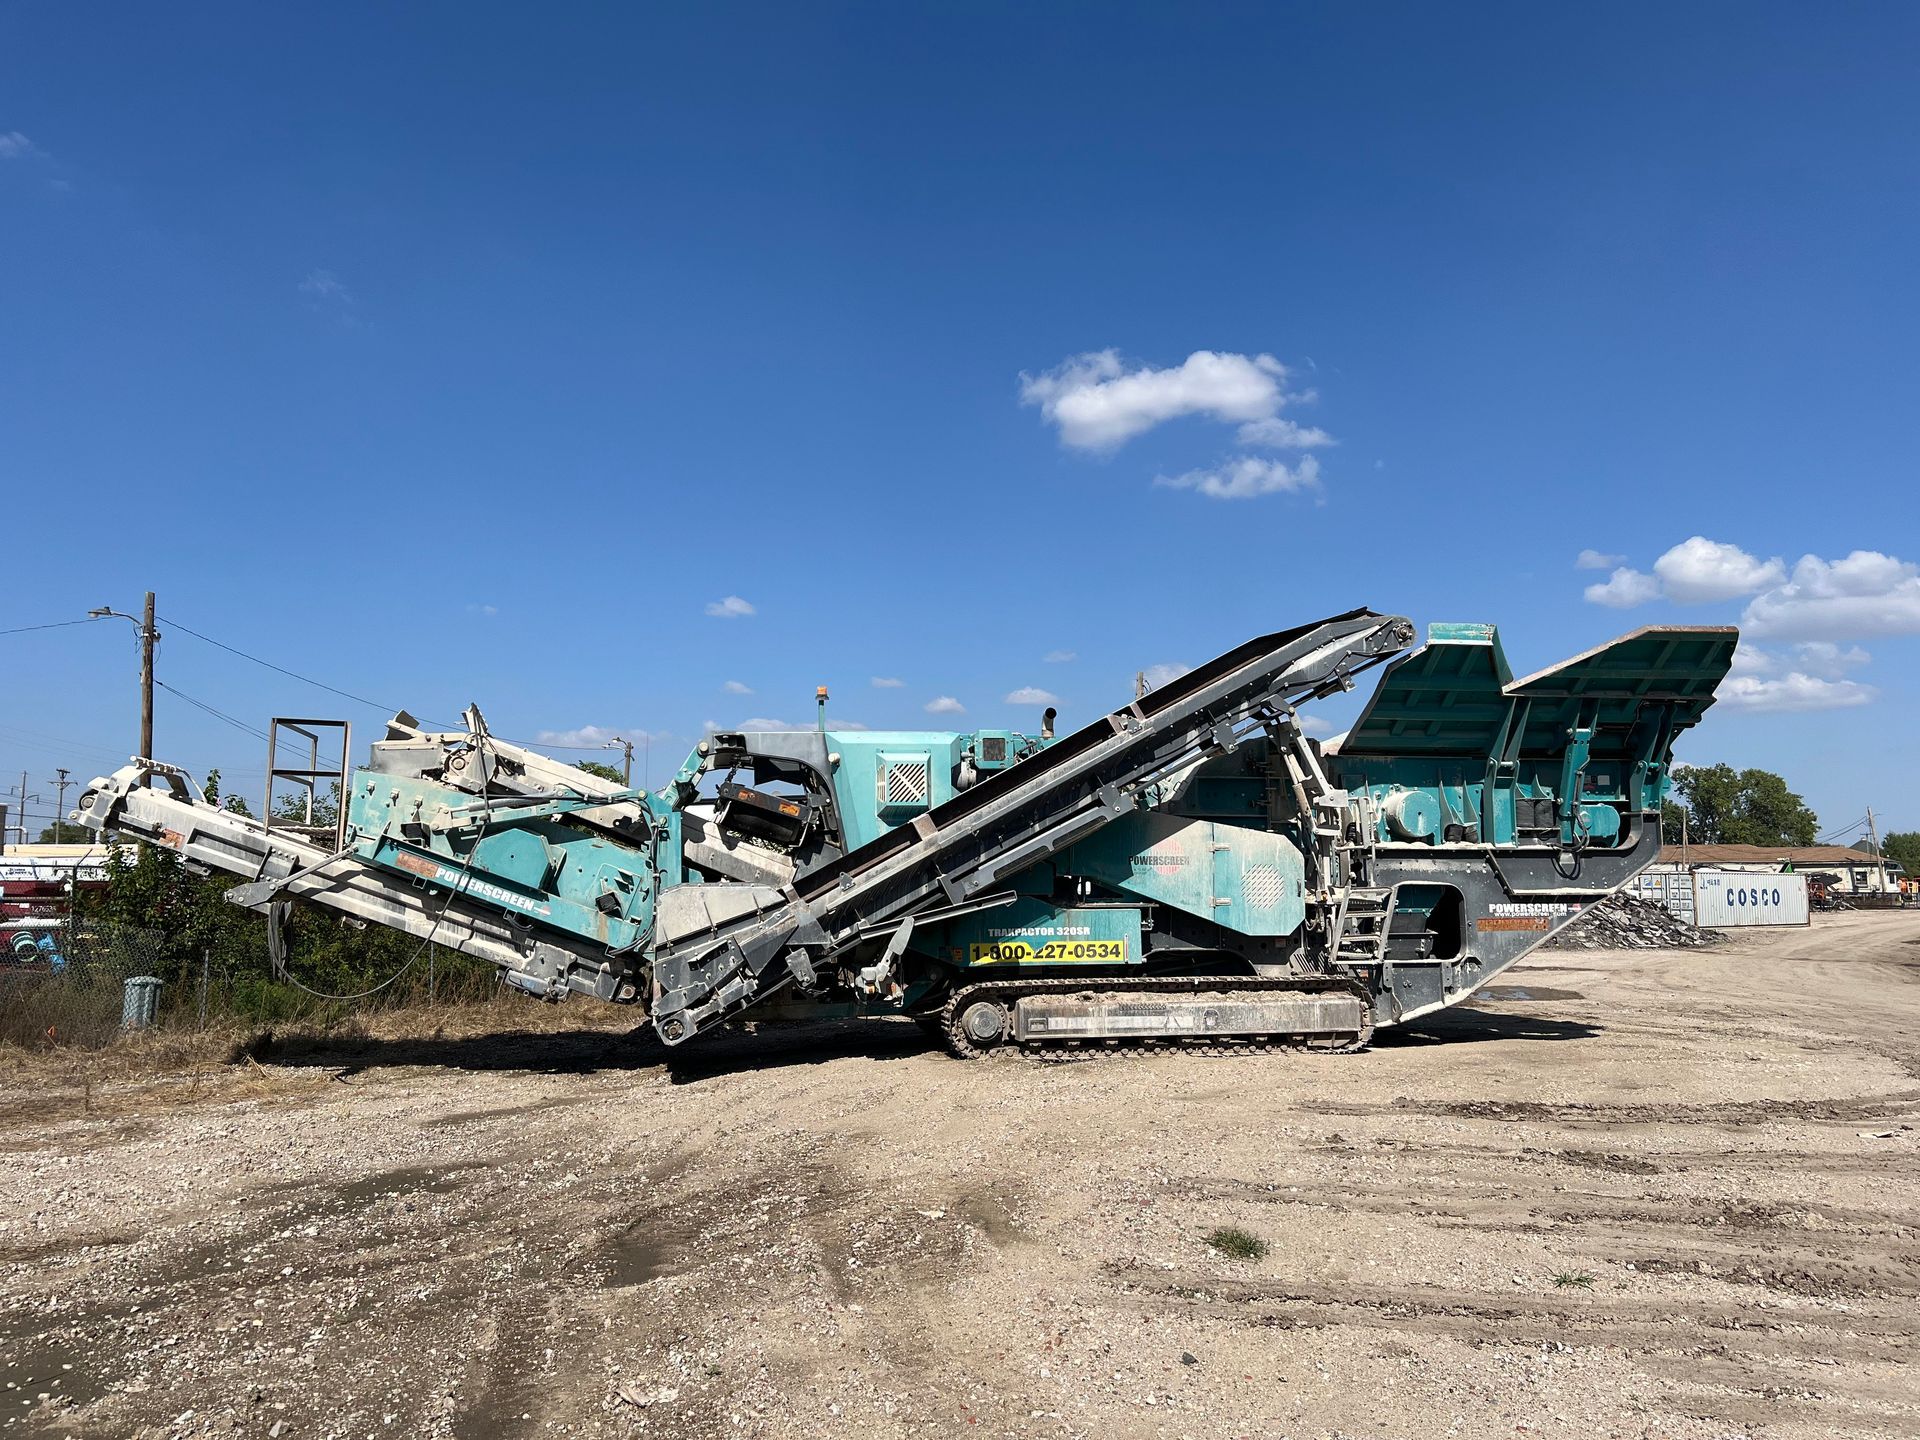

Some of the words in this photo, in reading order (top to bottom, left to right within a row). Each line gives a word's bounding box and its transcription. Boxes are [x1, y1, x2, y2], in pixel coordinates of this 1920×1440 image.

[1128, 855, 1190, 866] POWERSCREEN
[435, 866, 535, 911] POWERSCREEN
[1726, 888, 1781, 907] COSCO
[1488, 903, 1567, 913] POWERSCREEN
[988, 928, 1054, 937] TRAKPACTOR
[1056, 927, 1091, 936] 320SR
[972, 943, 1121, 960] 1-800-227-0534
